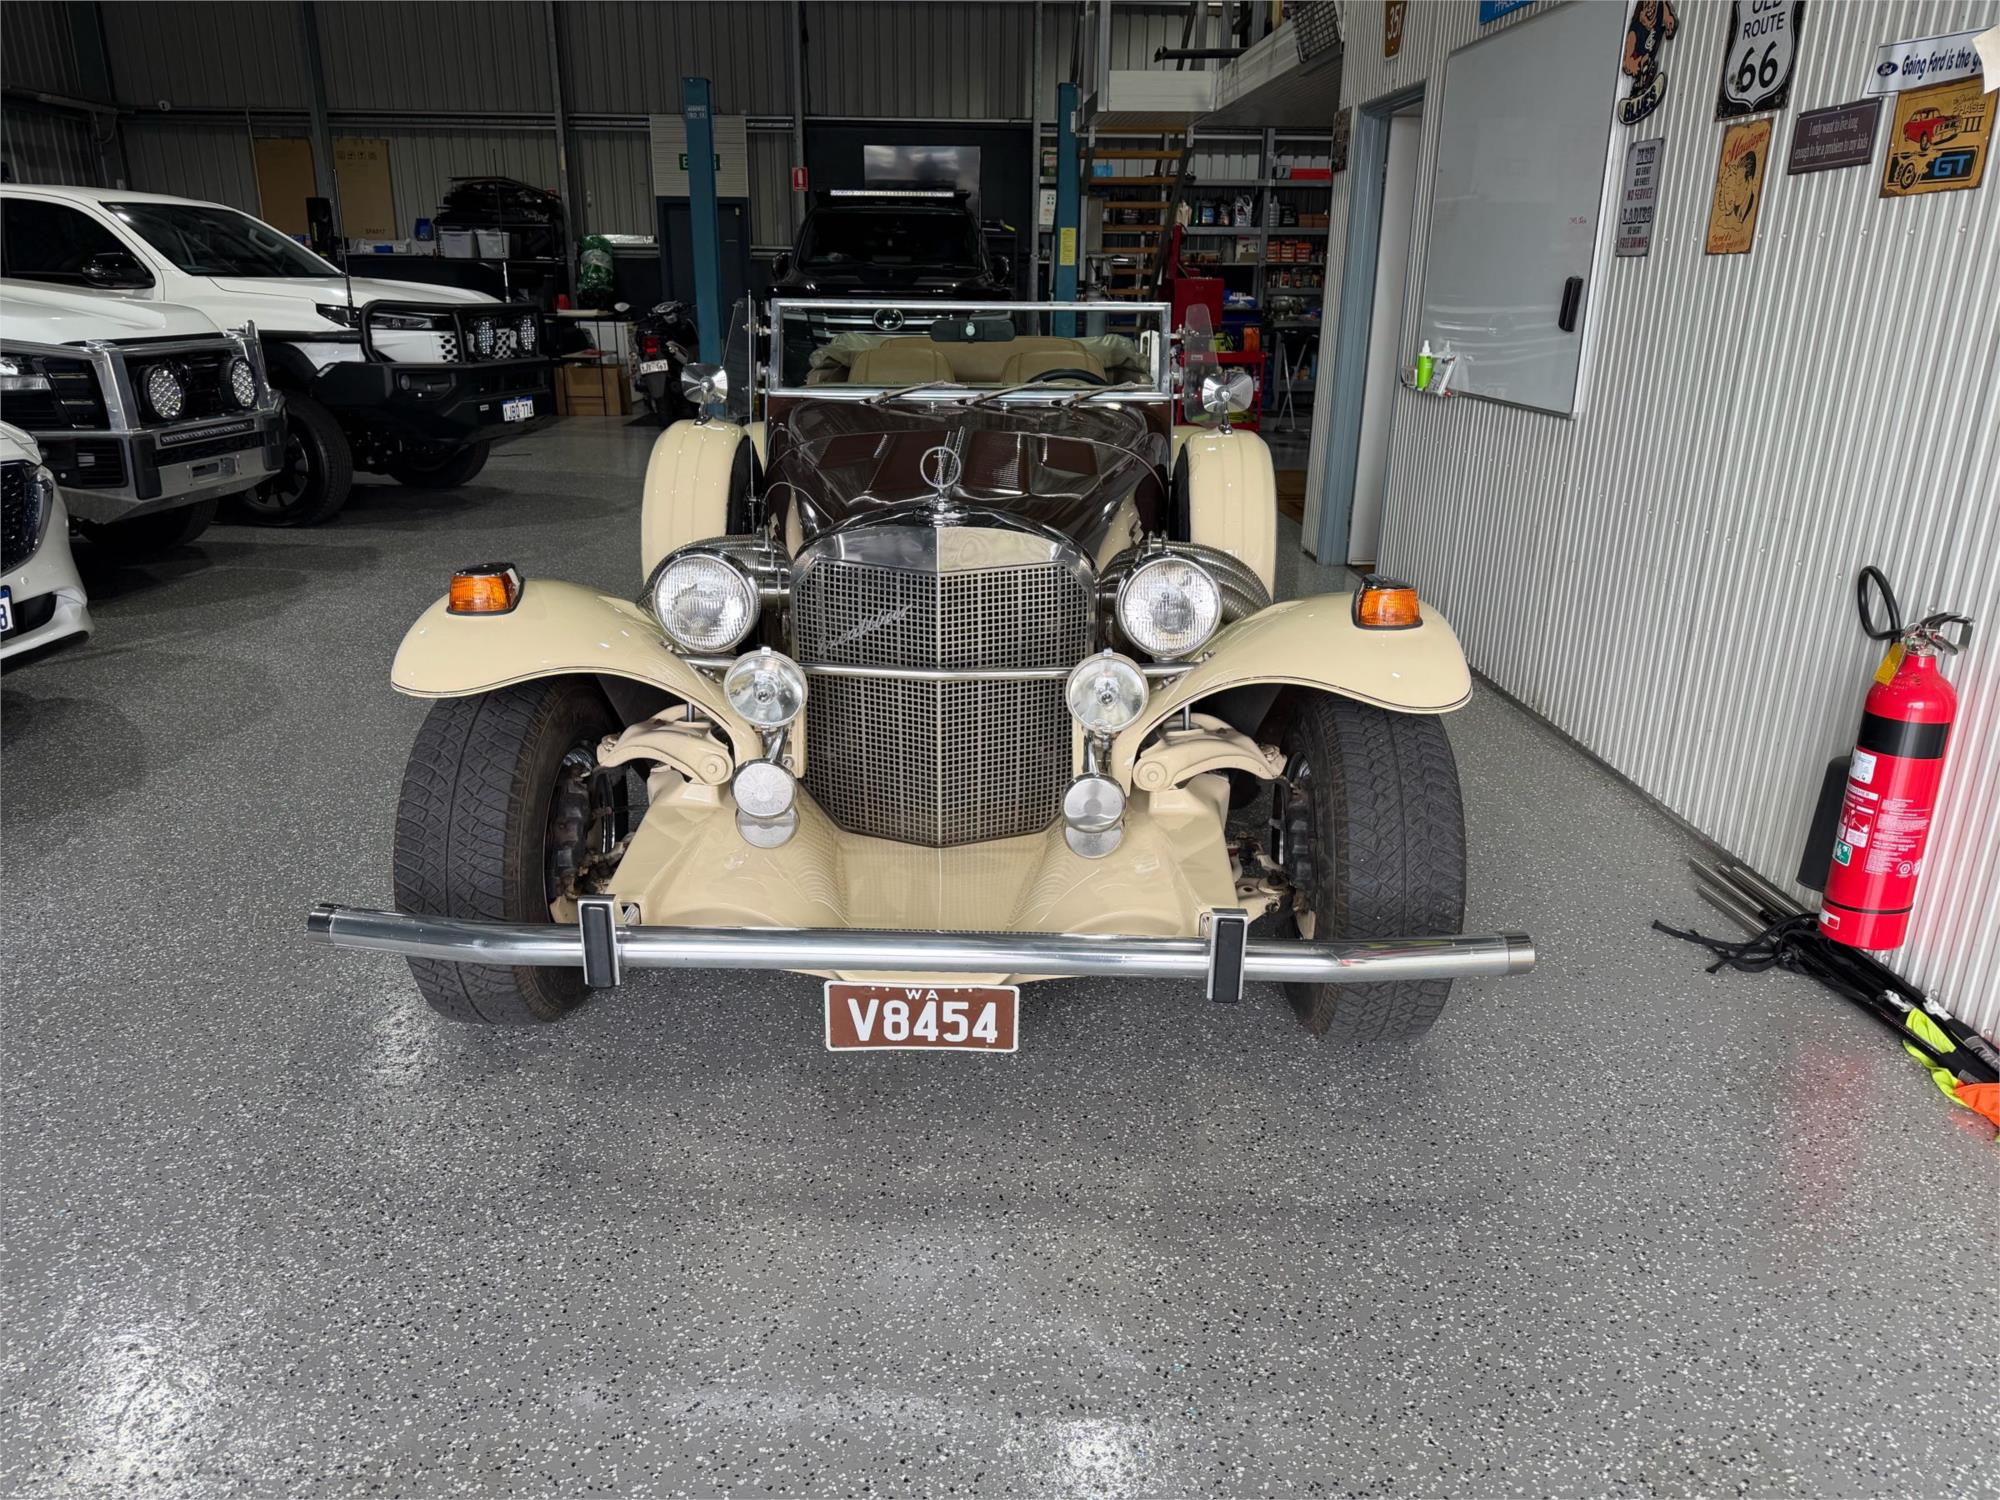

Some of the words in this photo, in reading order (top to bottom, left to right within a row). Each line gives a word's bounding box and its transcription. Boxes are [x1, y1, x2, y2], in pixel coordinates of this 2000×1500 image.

[1743, 11, 1785, 40] ROUTE
[1736, 40, 1778, 93] 66
[1902, 54, 1926, 80] Going
[1927, 51, 1945, 72] Ford
[1946, 48, 1954, 70] is
[1955, 46, 1971, 68] the
[1934, 154, 1971, 177] GT
[905, 988, 940, 1001] WA
[848, 999, 998, 1043] V8454
